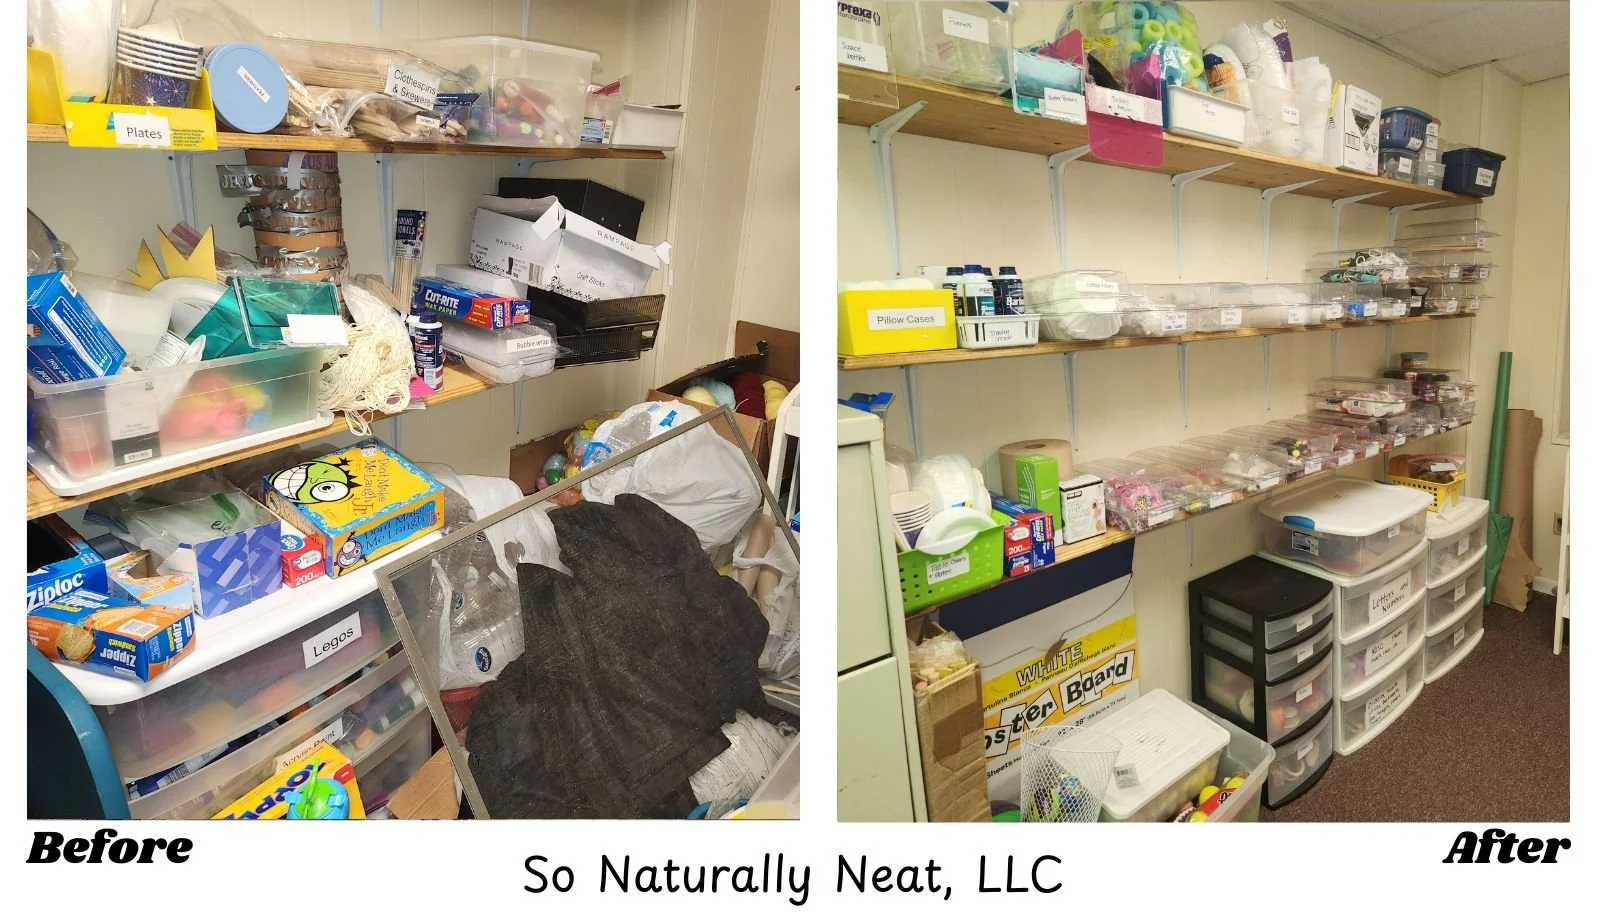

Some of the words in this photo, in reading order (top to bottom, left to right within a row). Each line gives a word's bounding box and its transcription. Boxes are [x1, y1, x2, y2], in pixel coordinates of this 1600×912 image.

[394, 69, 437, 95] Clothespins
[392, 83, 398, 94] &
[400, 86, 431, 107] Skewers
[126, 126, 163, 140] Plates
[595, 229, 635, 252] RAMPAGE
[424, 288, 460, 310] CUT-RITE
[438, 306, 457, 316] PAPER
[876, 315, 905, 325] Pillow
[906, 314, 936, 324] Cases
[536, 339, 550, 348] wrap
[364, 459, 377, 474] Me
[360, 474, 376, 504] Laugh
[352, 497, 374, 517] Jr.
[393, 506, 426, 527] Make
[365, 533, 385, 551] Me
[387, 516, 426, 541] Laugh
[1008, 544, 1023, 556] 200
[929, 561, 950, 573] Table
[295, 573, 314, 587] 200
[26, 572, 84, 612] Ziploc
[172, 621, 184, 653] Zipper
[313, 626, 354, 658] Legos
[100, 647, 137, 668] Zipper
[1016, 641, 1083, 687] WHITE
[1008, 684, 1032, 699] Blanca
[1041, 666, 1068, 683] Panneau
[984, 701, 1053, 751] oster
[1066, 656, 1128, 705] Board
[986, 760, 1013, 779] Sheets
